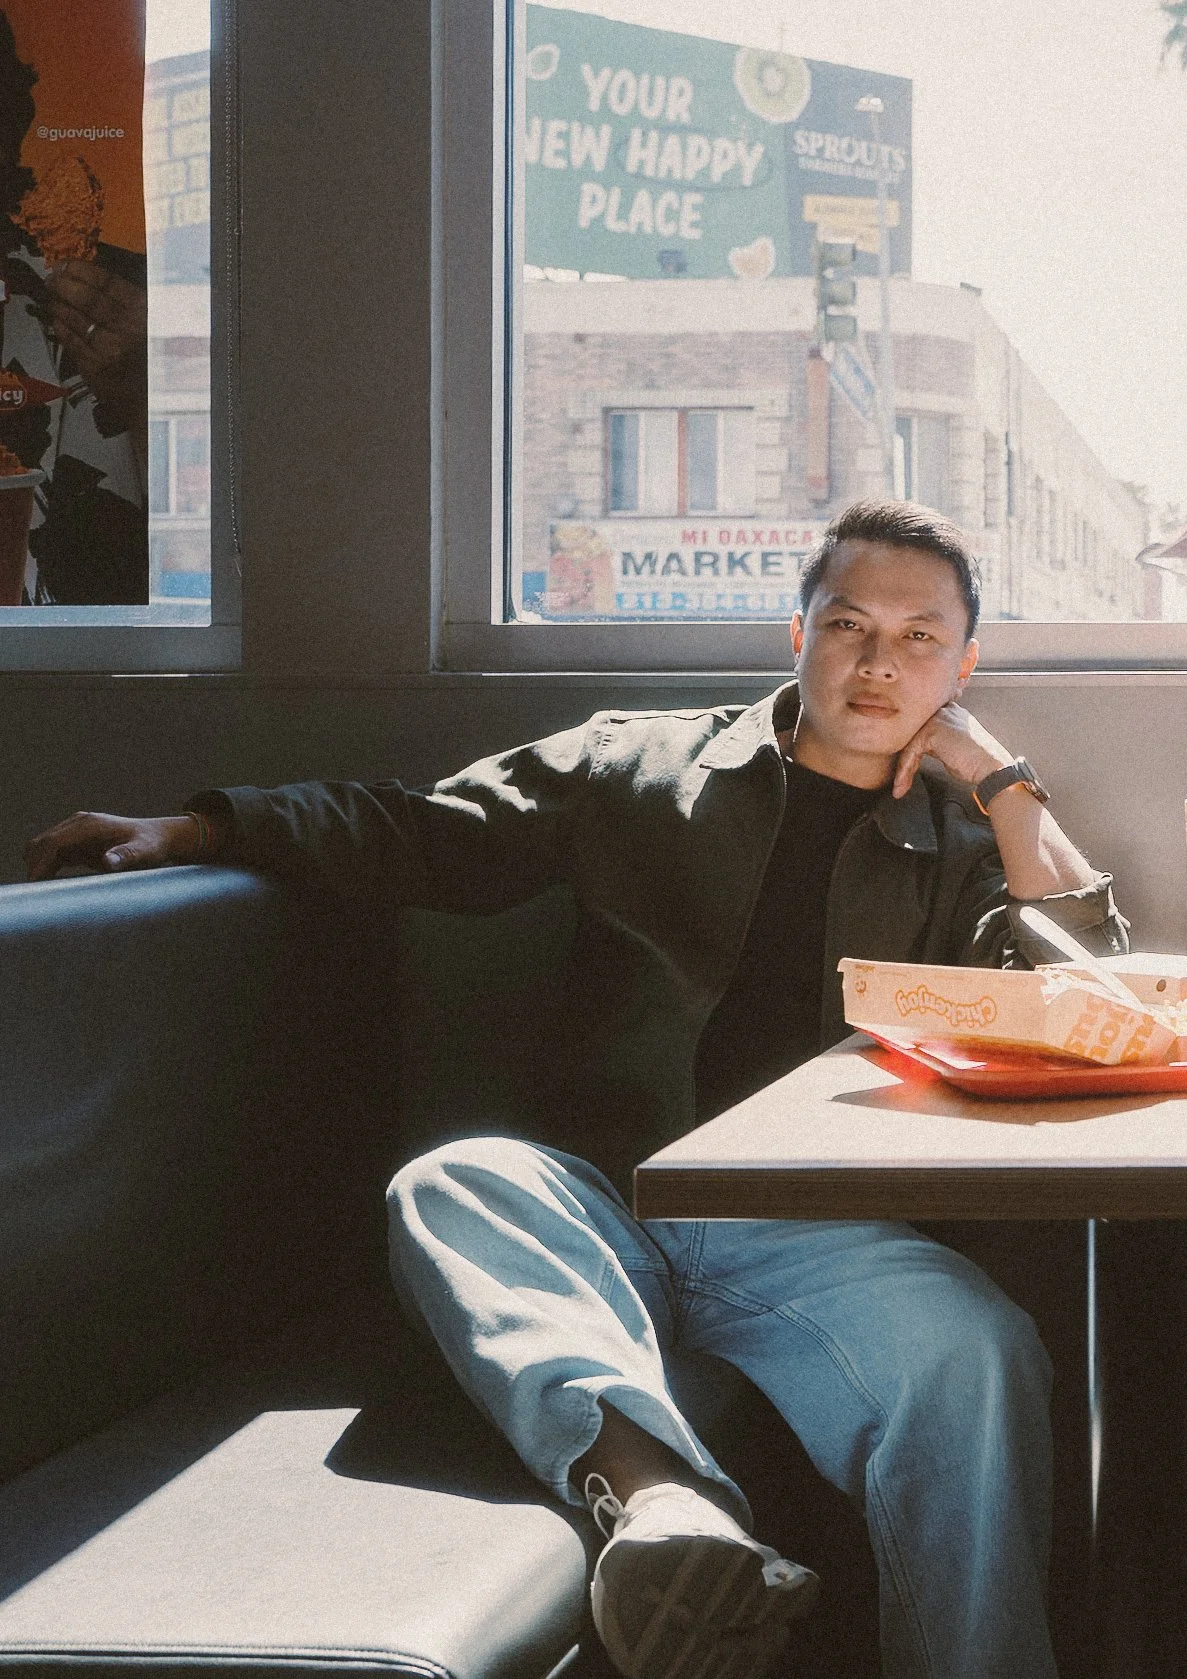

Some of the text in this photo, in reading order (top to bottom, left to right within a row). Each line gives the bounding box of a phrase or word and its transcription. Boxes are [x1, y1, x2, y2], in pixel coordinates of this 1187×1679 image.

[581, 63, 694, 125] YOUR
[37, 126, 125, 141] @guavajuice
[626, 125, 765, 186] HAPPY
[792, 128, 907, 173] SPROUTS
[578, 182, 704, 240] PLACE
[681, 529, 709, 545] MI
[719, 529, 813, 546] OAXACA
[621, 551, 808, 577] MARKET
[896, 984, 998, 1028] Chickenjoy
